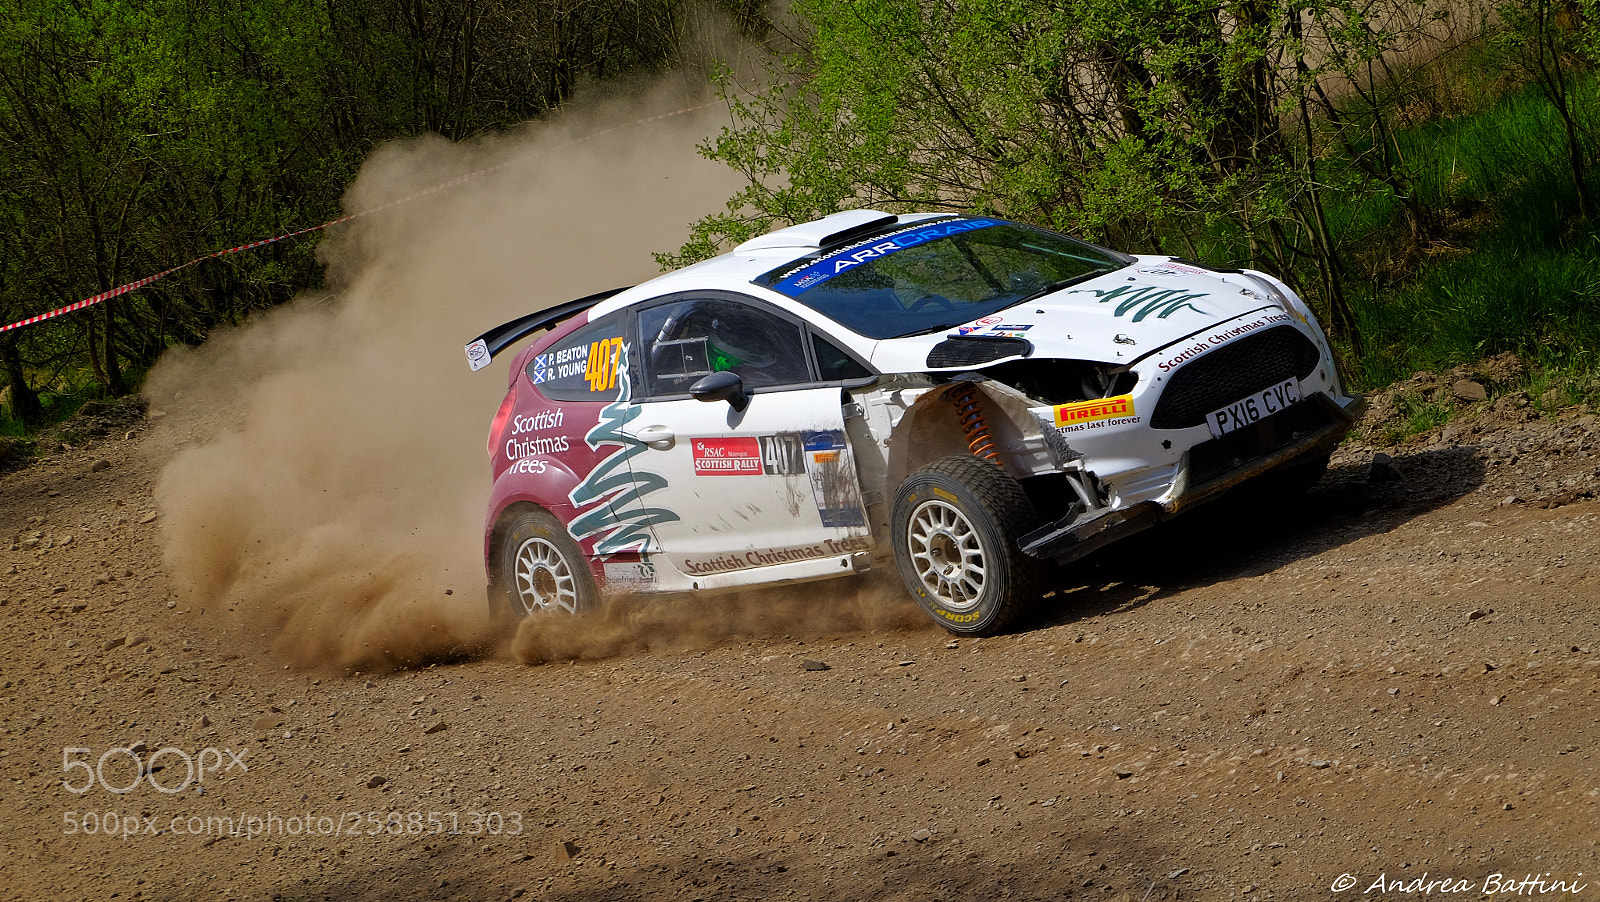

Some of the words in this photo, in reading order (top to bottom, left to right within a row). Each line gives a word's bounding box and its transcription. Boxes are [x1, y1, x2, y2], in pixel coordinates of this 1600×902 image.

[548, 353, 555, 366] P.
[556, 345, 588, 364] BEATON
[1158, 341, 1210, 372] Scottish
[1208, 320, 1265, 345] Christmas
[1262, 313, 1291, 324] Trees
[547, 367, 556, 382] R.
[558, 360, 588, 378] YOUNG
[584, 336, 623, 392] 407
[511, 407, 564, 435] Scottish
[1060, 399, 1126, 422] PIRELLI
[1215, 401, 1260, 435] PX16
[1262, 381, 1297, 412] CVC
[1087, 421, 1105, 430] last
[1108, 416, 1141, 426] forever
[506, 435, 569, 461] Christmas
[704, 447, 725, 457] RSAC
[765, 436, 798, 475] 407
[695, 459, 732, 471] SCOTTISH
[734, 459, 759, 471] RALLY
[685, 552, 745, 574] Scottish
[745, 543, 825, 566] Christmas
[823, 537, 870, 553] Trees
